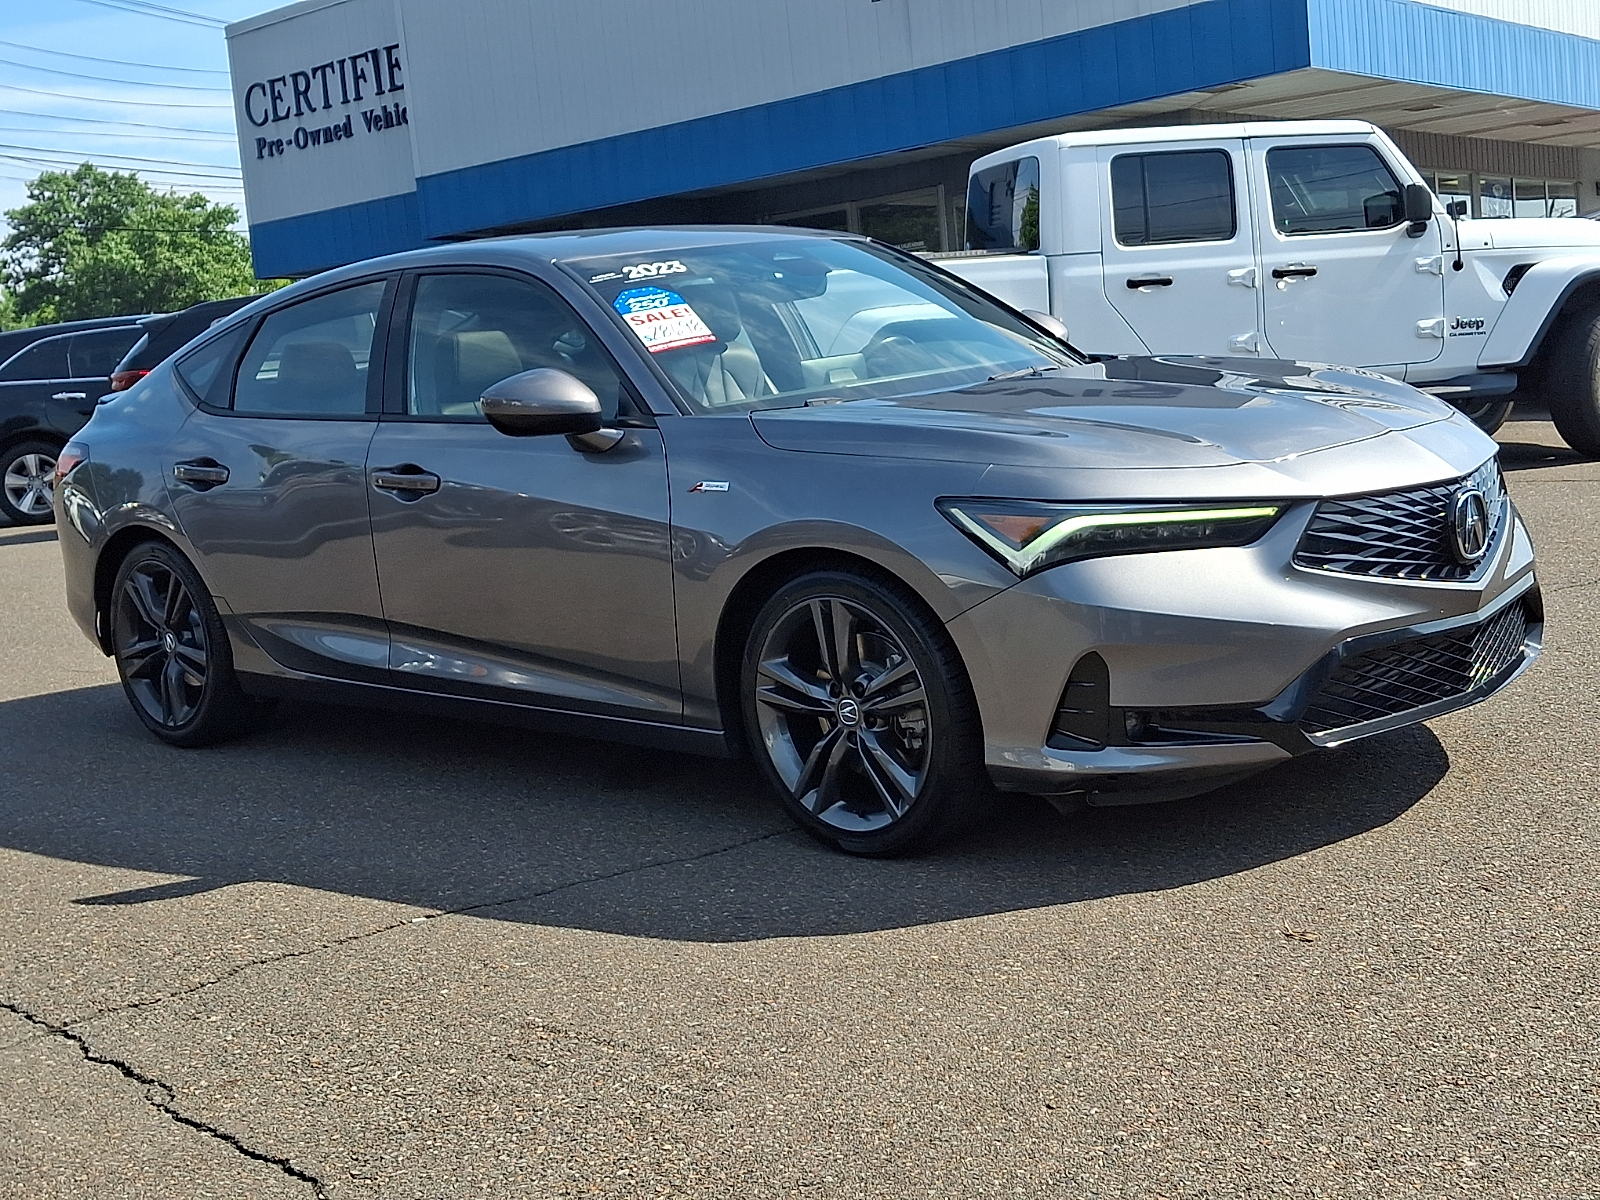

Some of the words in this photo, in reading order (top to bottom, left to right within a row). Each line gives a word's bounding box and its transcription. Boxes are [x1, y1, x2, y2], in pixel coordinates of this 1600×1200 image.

[255, 114, 353, 159] Pre-Owned
[622, 260, 687, 279] 2023
[630, 307, 692, 326] SALE!
[1450, 315, 1485, 330] Jeep
